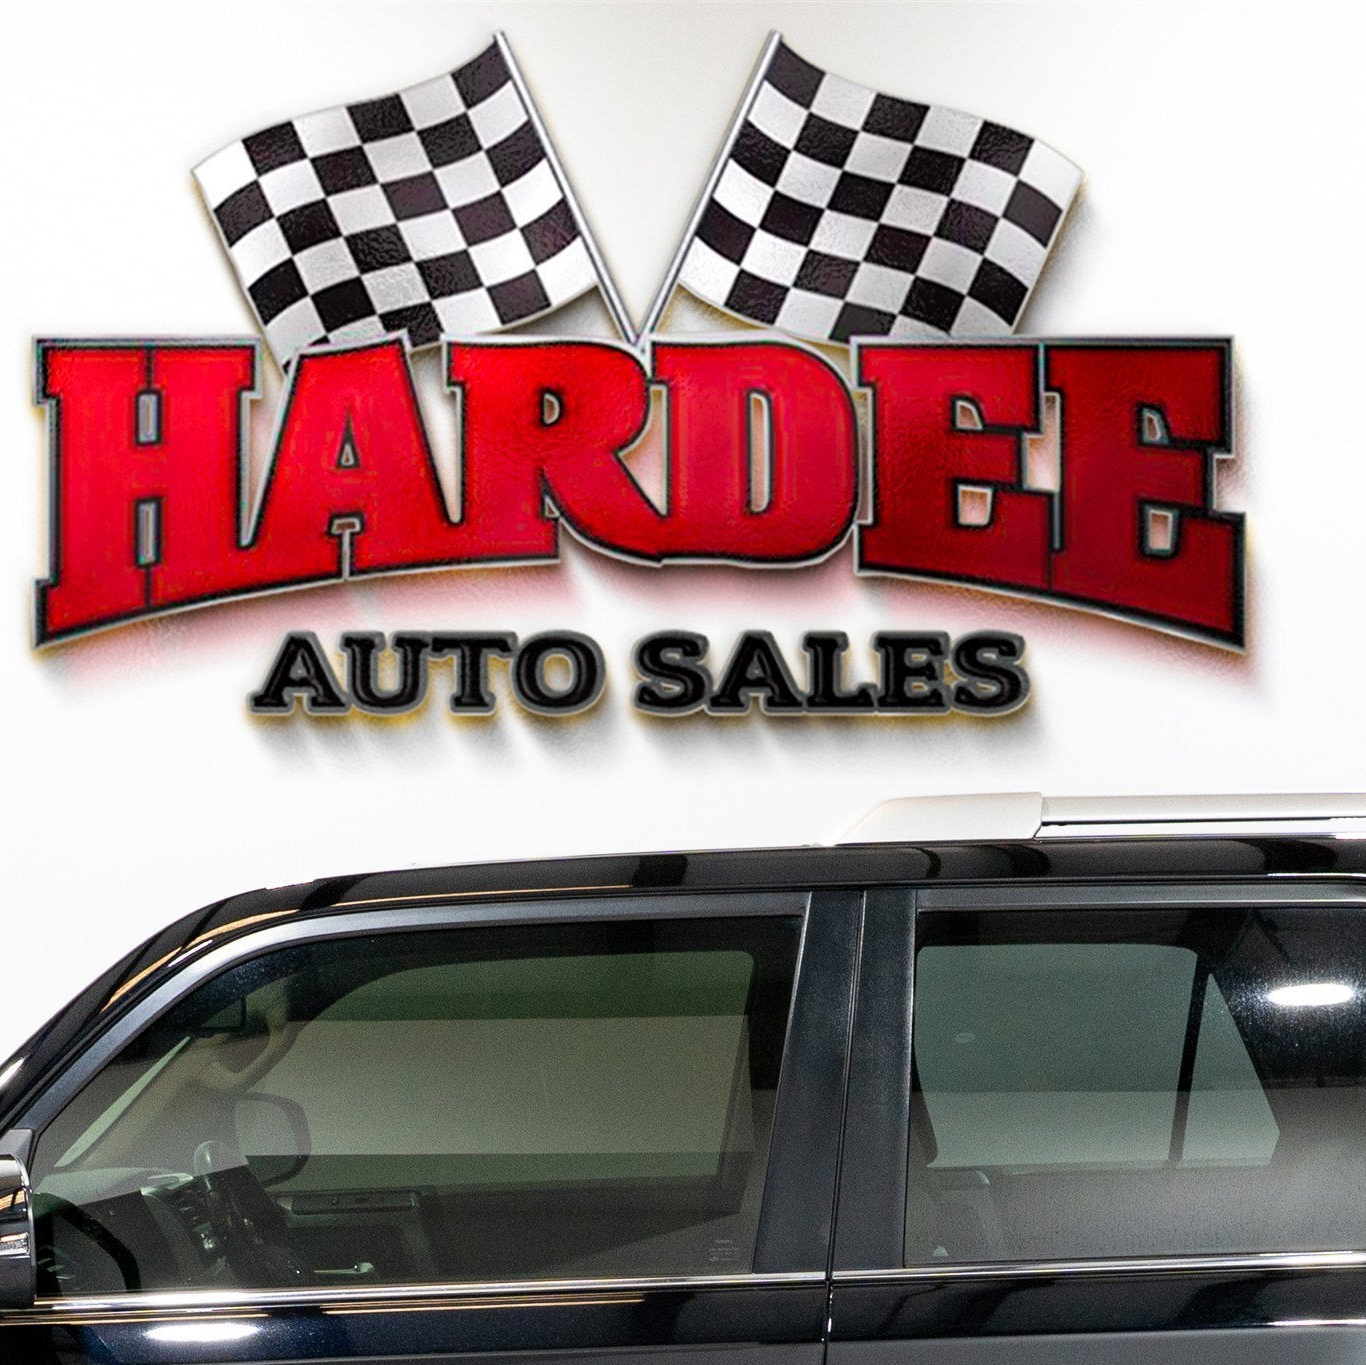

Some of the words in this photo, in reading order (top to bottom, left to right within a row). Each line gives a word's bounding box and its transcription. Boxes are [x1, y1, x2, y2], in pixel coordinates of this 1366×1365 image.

[36, 338, 1245, 652] HARDEE
[248, 630, 607, 716] AUTO
[633, 630, 1032, 716] SALES
